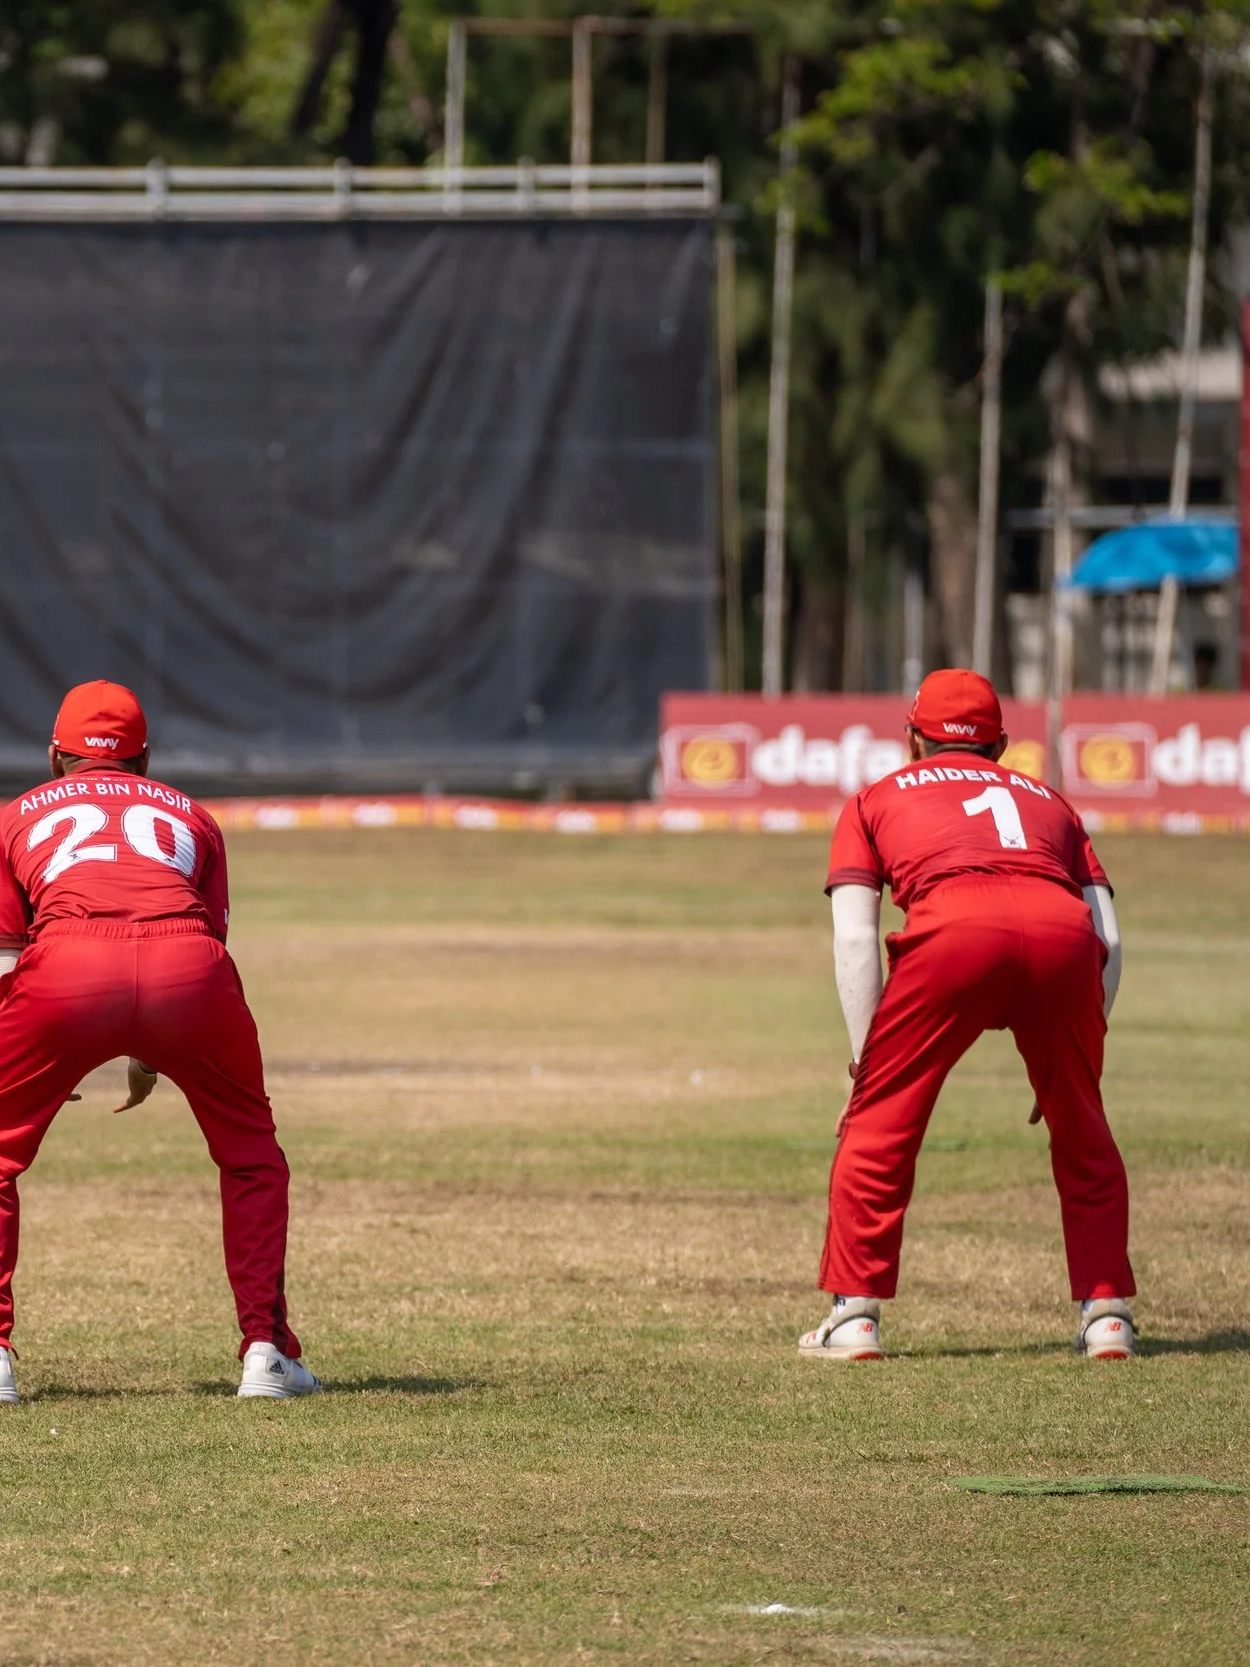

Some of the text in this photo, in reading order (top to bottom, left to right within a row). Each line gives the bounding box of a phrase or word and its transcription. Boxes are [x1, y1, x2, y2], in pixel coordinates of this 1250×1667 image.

[20, 782, 192, 815] AHMER BIN NASIR
[895, 767, 1052, 800] HAIDER ALI
[961, 785, 1028, 850] 1
[26, 803, 197, 884] 20
